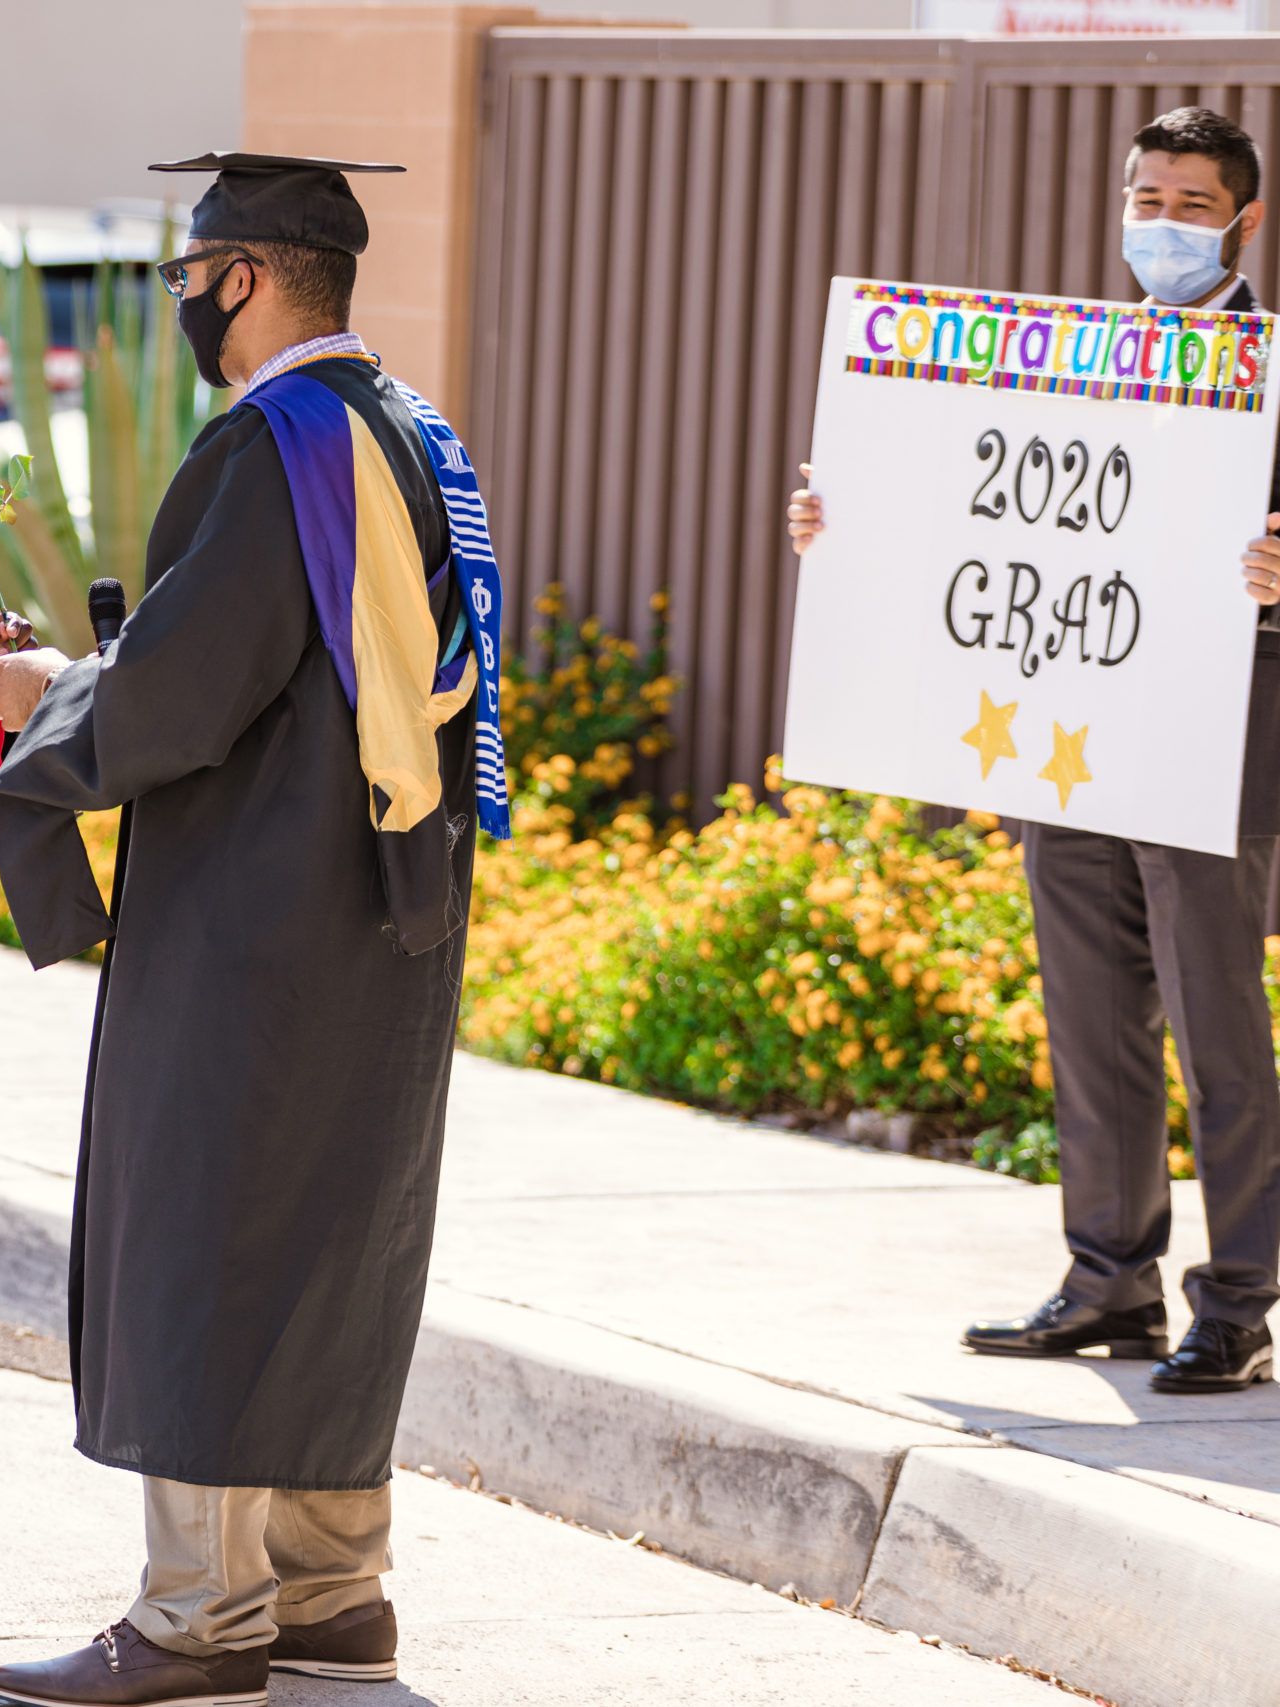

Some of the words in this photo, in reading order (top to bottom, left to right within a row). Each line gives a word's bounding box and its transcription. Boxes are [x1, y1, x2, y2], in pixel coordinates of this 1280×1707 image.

[866, 305, 1261, 389] congratulations
[970, 428, 1132, 534] 2020
[944, 559, 1141, 679] GRAD
